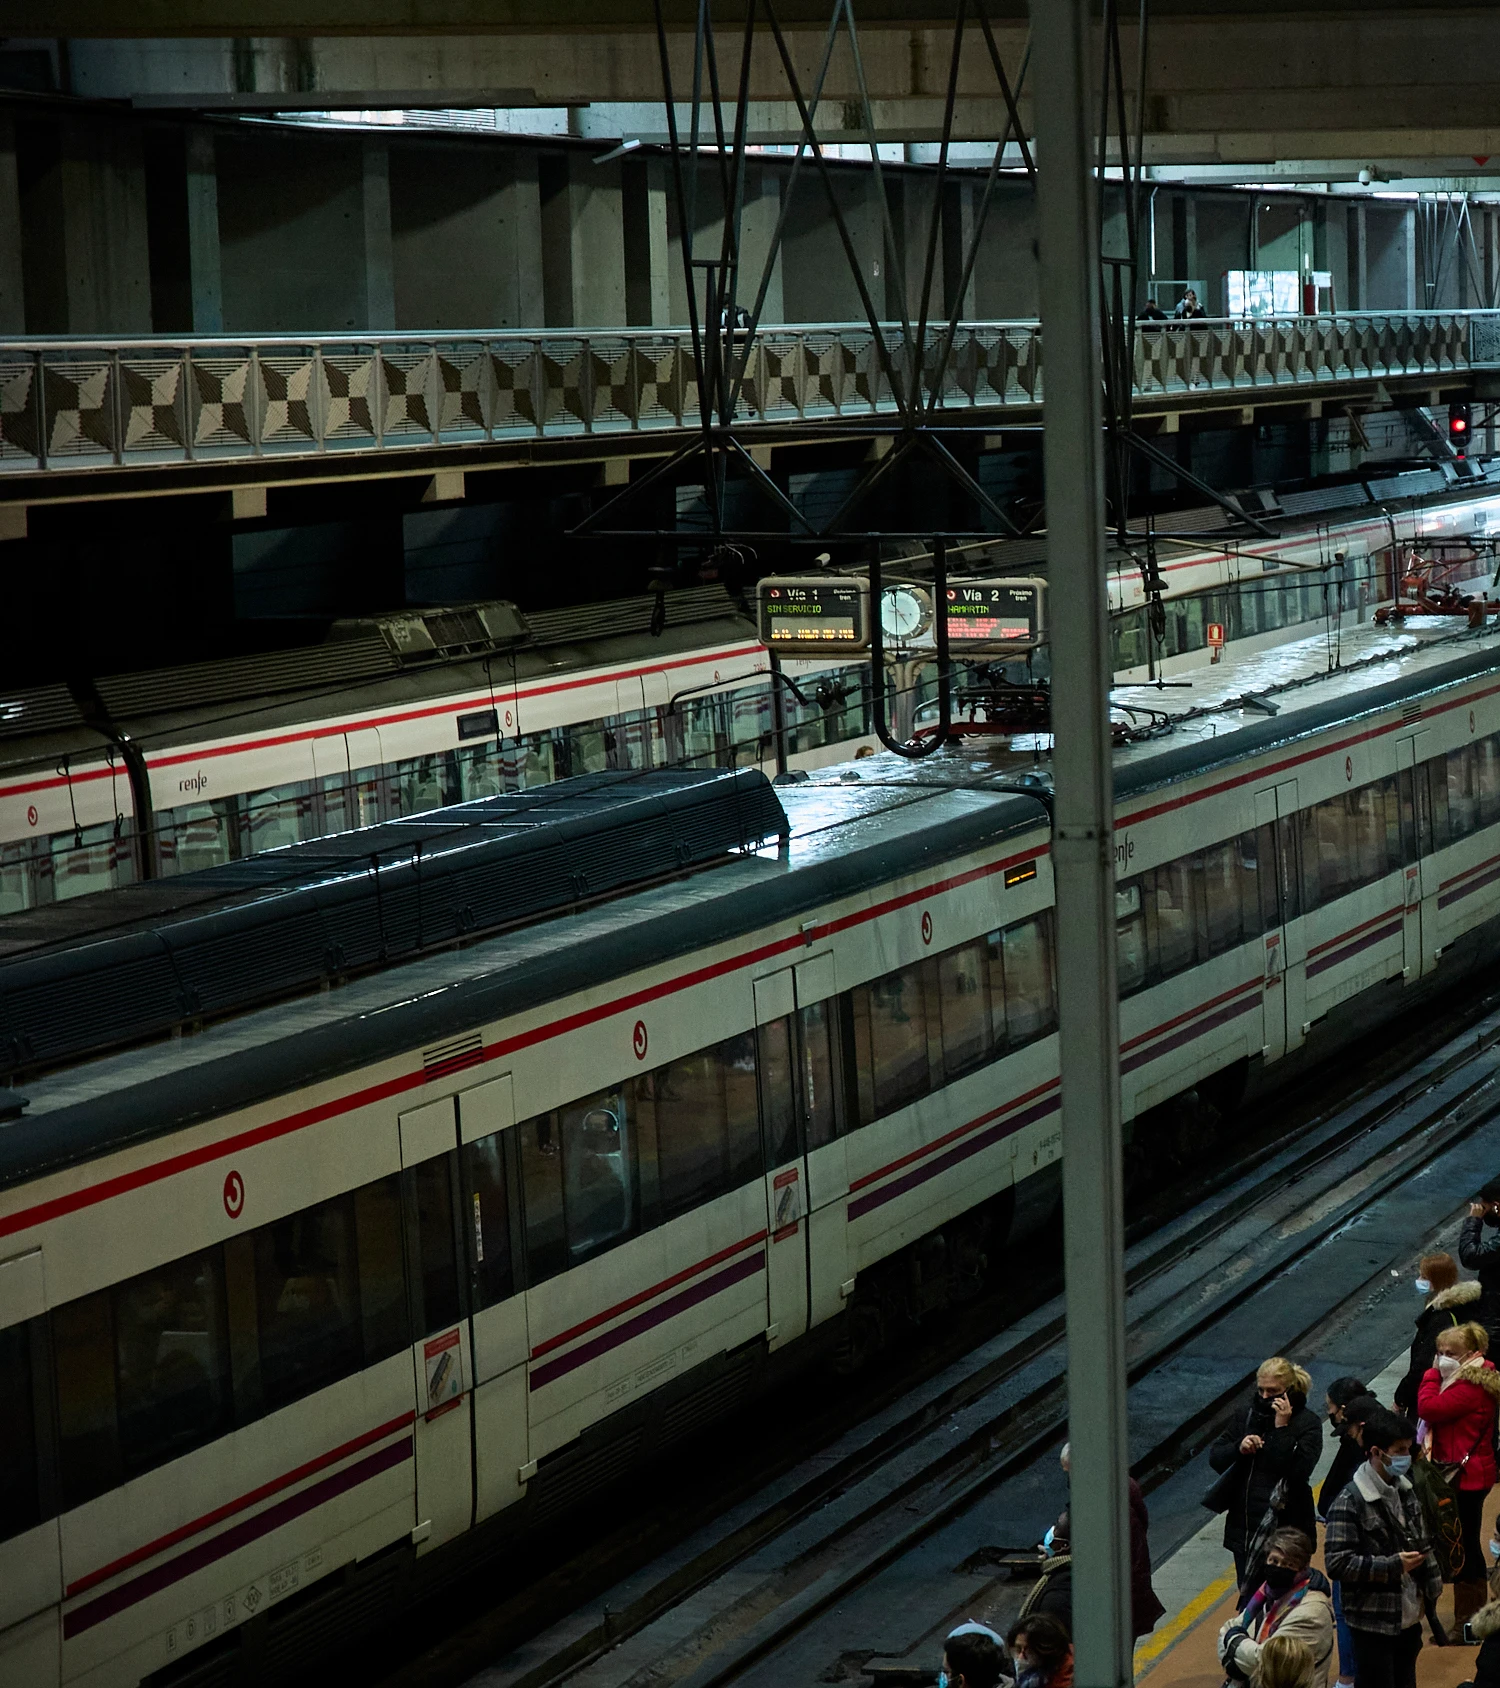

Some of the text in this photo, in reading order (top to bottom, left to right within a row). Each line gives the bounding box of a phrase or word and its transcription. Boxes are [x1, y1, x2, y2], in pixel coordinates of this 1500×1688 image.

[811, 588, 818, 601] 1
[963, 588, 1000, 602] Vía 2
[767, 604, 822, 614] SIN SERVICIO
[947, 605, 989, 615] HAMARTIN
[179, 770, 207, 796] renfe
[1113, 831, 1134, 871] enfe
